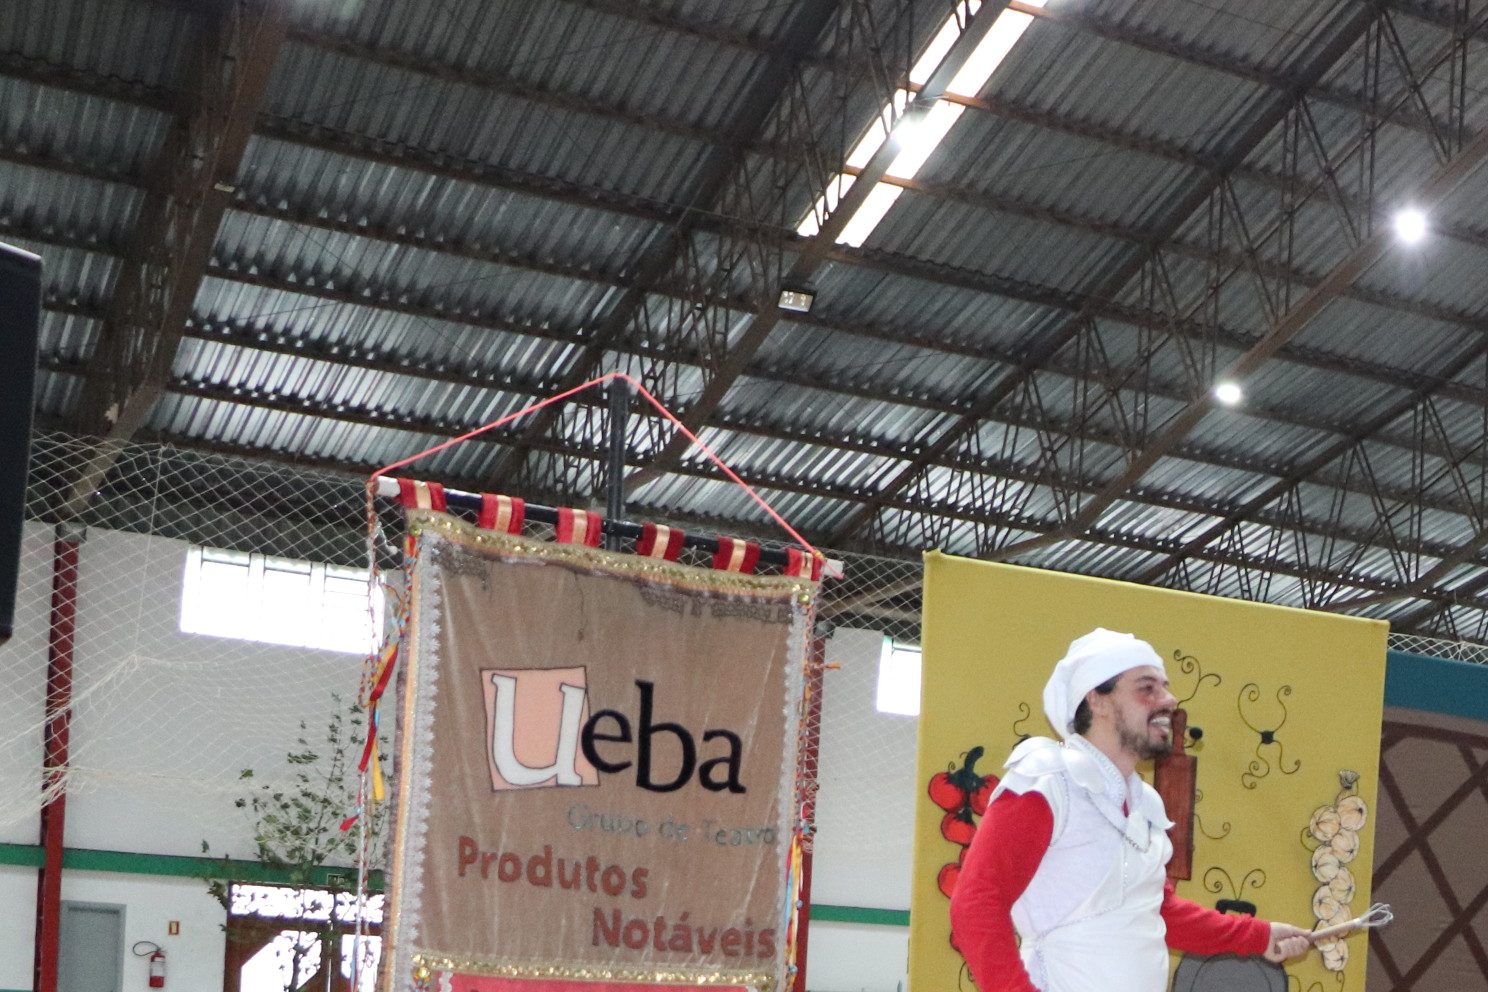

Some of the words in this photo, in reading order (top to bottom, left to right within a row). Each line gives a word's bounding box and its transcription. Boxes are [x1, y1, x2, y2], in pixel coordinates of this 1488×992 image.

[490, 673, 747, 794] Ueba
[658, 814, 690, 842] de
[457, 835, 650, 900] Produtos
[591, 906, 777, 959] Notáveis
